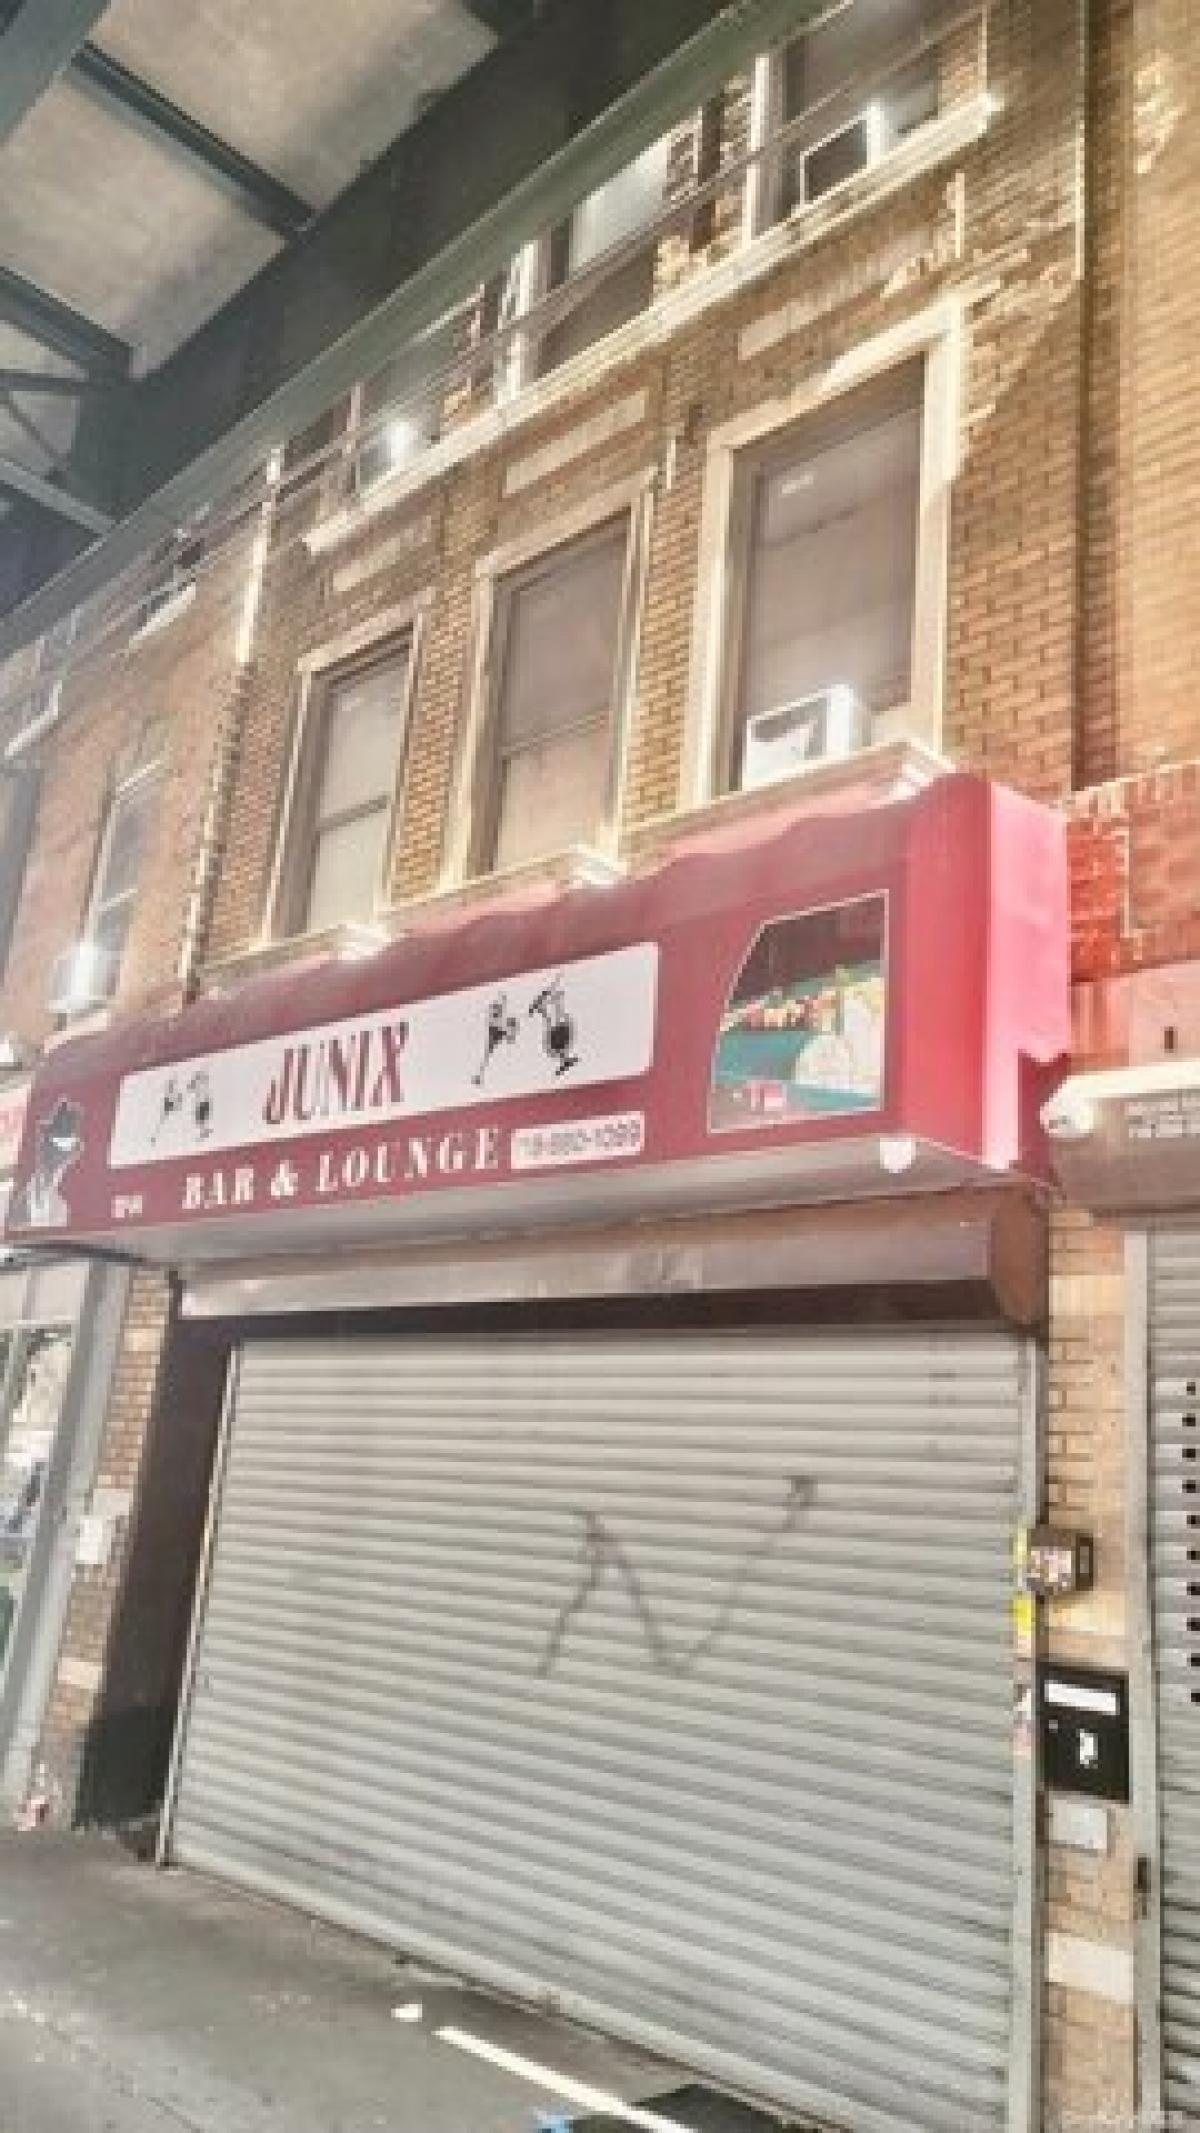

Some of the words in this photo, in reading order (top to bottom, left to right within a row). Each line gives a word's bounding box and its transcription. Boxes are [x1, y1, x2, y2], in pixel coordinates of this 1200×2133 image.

[262, 1021, 409, 1125] JUNIX
[182, 1166, 255, 1210] BAR
[270, 1158, 299, 1197] &
[315, 1128, 499, 1192] LOUNGE
